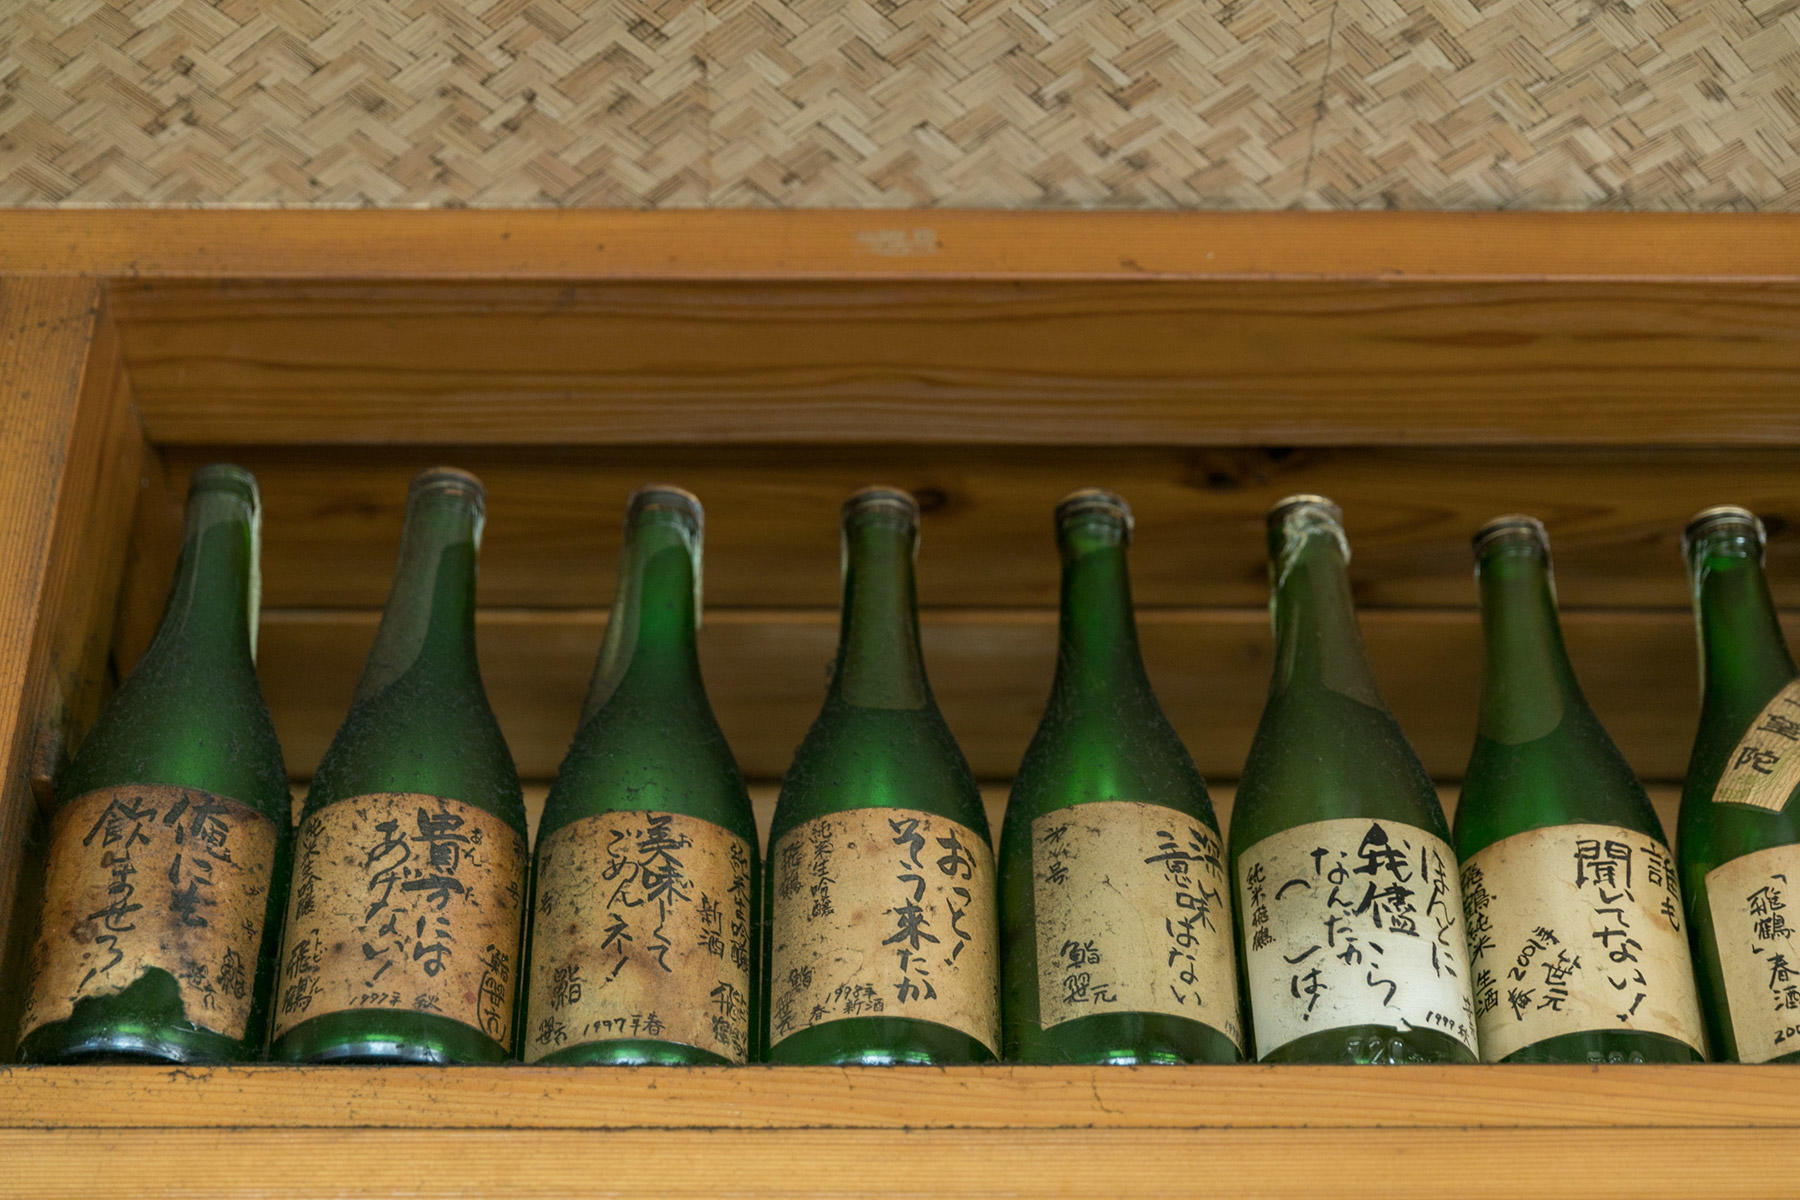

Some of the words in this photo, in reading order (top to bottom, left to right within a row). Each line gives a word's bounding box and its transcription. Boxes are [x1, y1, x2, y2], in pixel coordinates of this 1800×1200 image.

[637, 813, 693, 973] 美味しくて
[696, 891, 725, 960] 新酒
[882, 818, 941, 1005] そう来たか
[1573, 839, 1648, 1022] 聞いてない！
[1425, 1010, 1455, 1031] 1999
[1476, 968, 1499, 1019] 生酒
